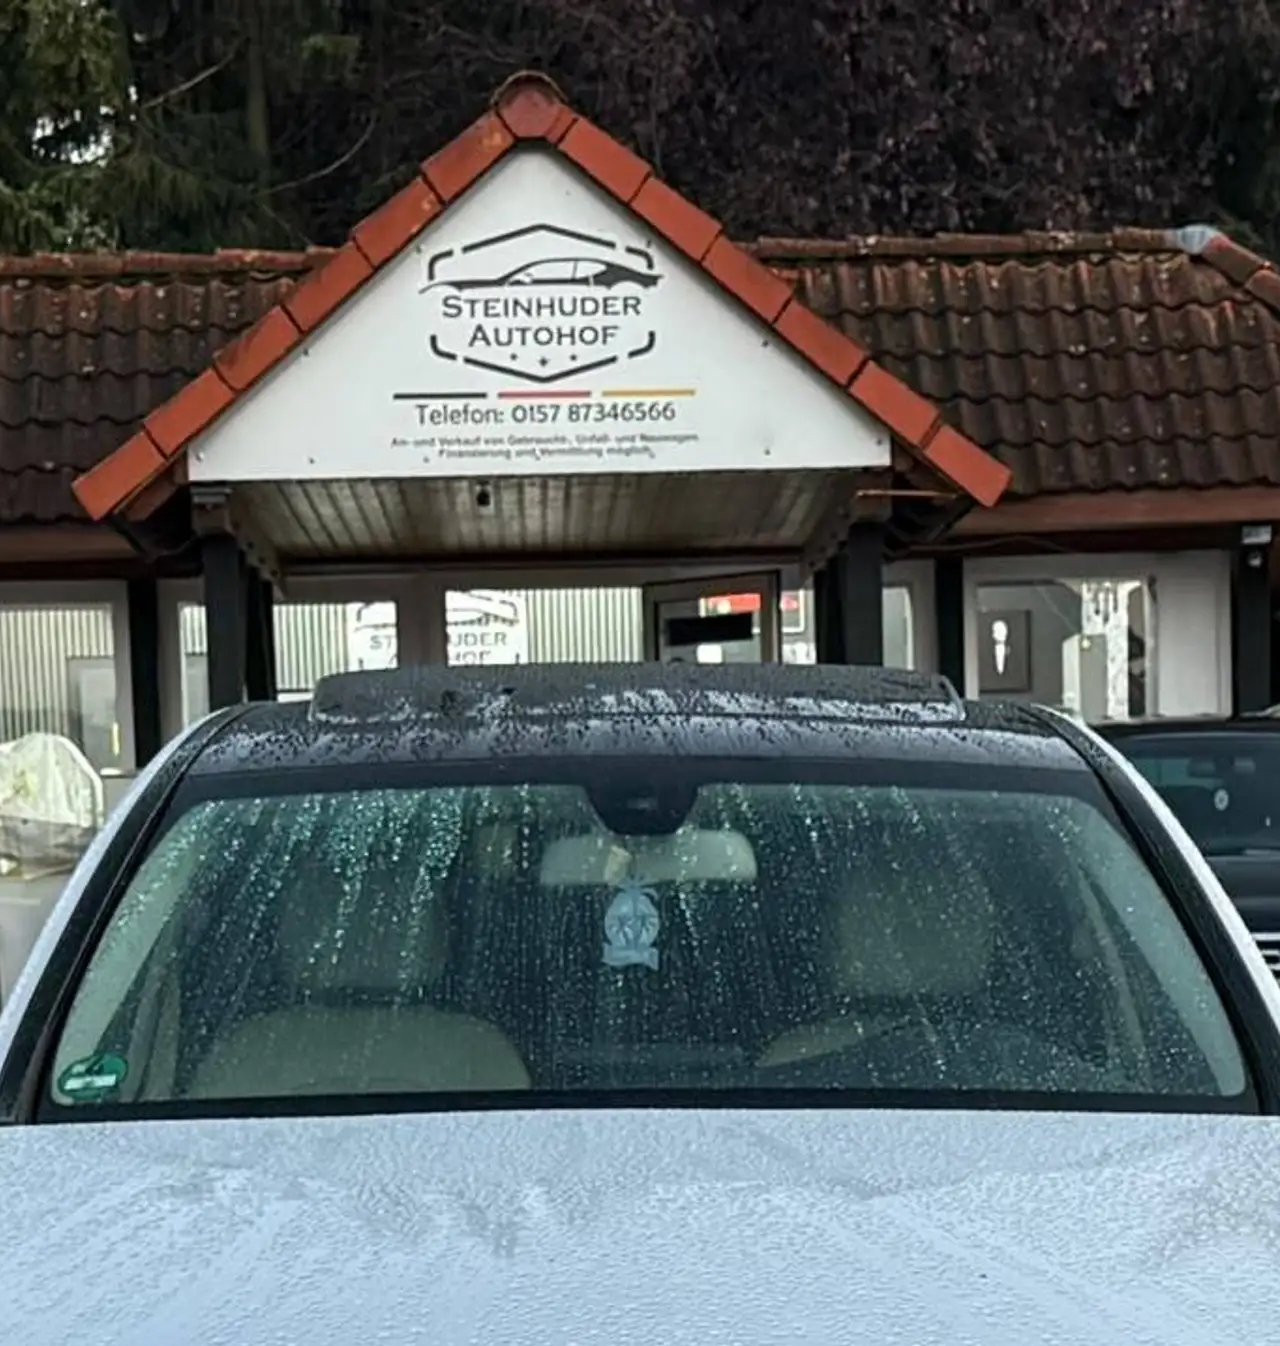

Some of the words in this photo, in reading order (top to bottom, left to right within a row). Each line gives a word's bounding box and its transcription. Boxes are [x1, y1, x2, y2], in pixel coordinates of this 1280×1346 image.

[442, 295, 641, 318] STEINHUDER
[468, 324, 619, 347] AUTOHOF
[415, 403, 504, 425] Telefon:
[511, 403, 561, 423] 0157
[568, 402, 676, 422] 87346566
